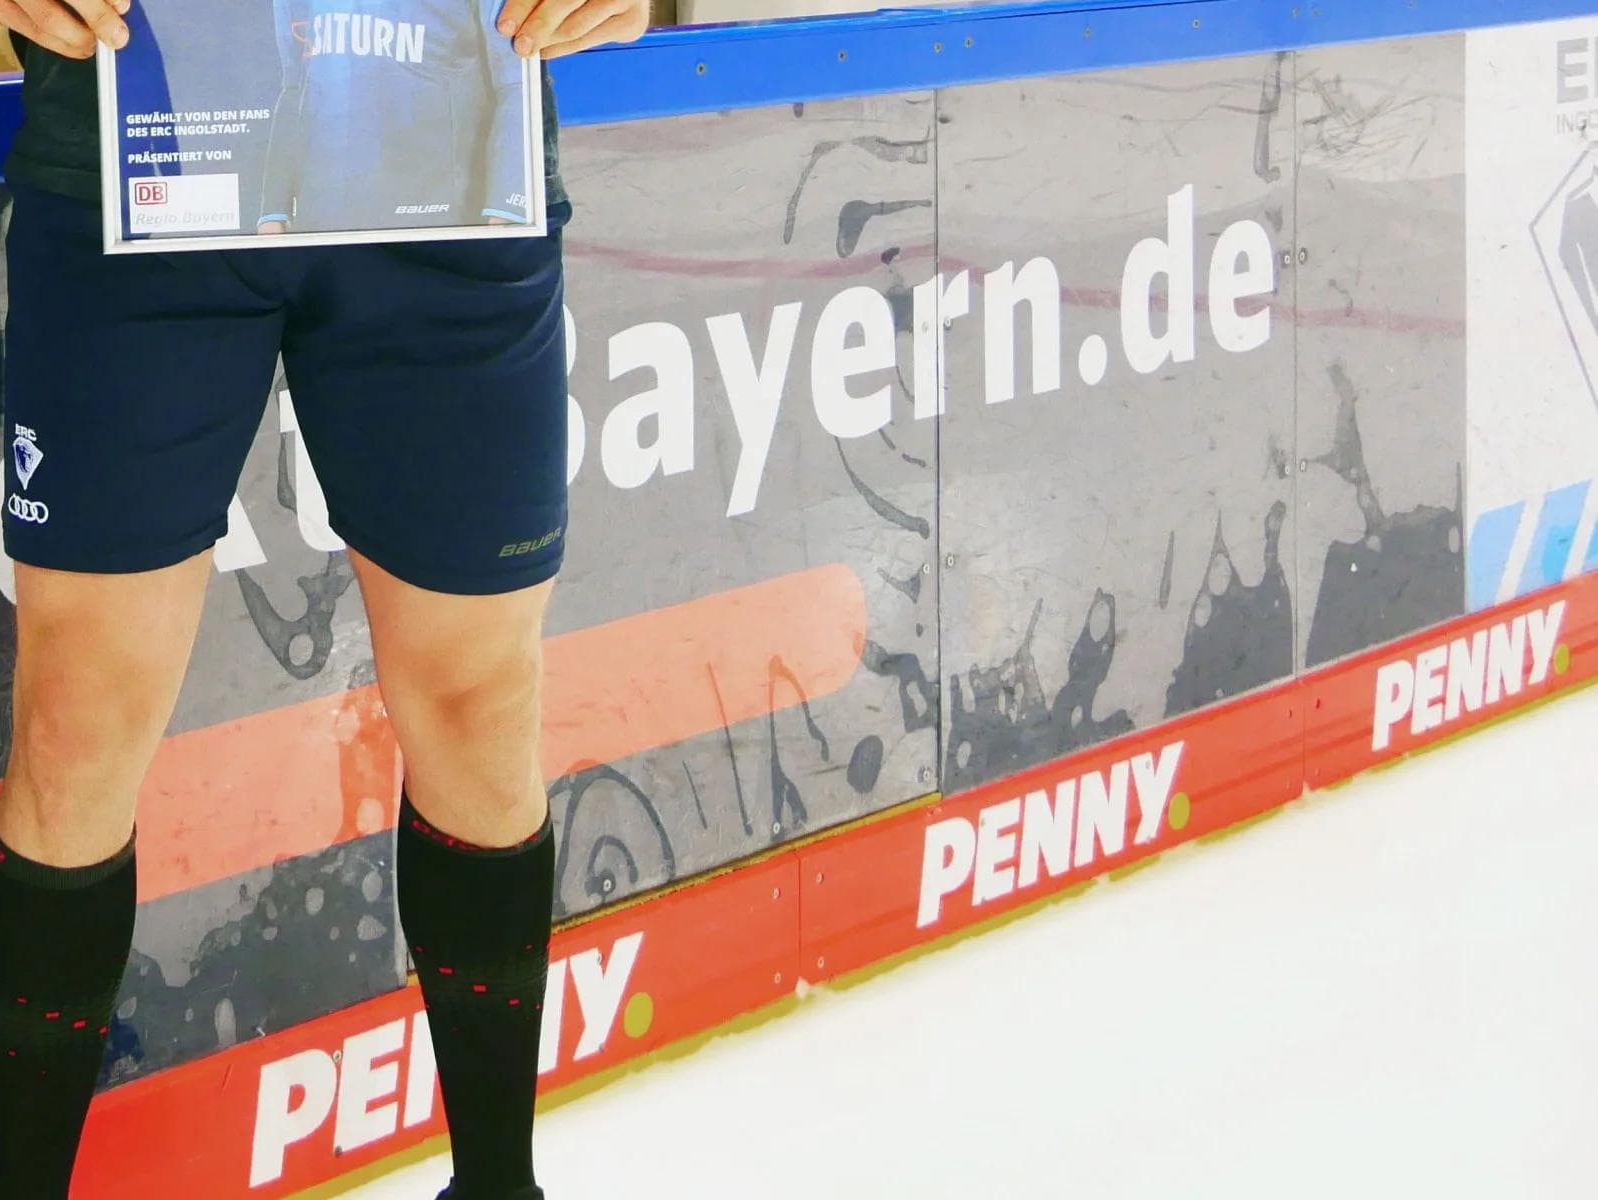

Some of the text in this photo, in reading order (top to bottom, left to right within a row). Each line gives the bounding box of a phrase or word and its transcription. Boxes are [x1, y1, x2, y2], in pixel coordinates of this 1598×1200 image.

[312, 12, 426, 64] SATURN
[126, 109, 271, 125] GEWÄHLT VON DEN FANS
[127, 123, 251, 138] DES ERC INGOLSTADT.
[127, 150, 232, 164] PRÄSENTIERT VON
[137, 184, 165, 203] DB
[14, 424, 37, 441] ERC
